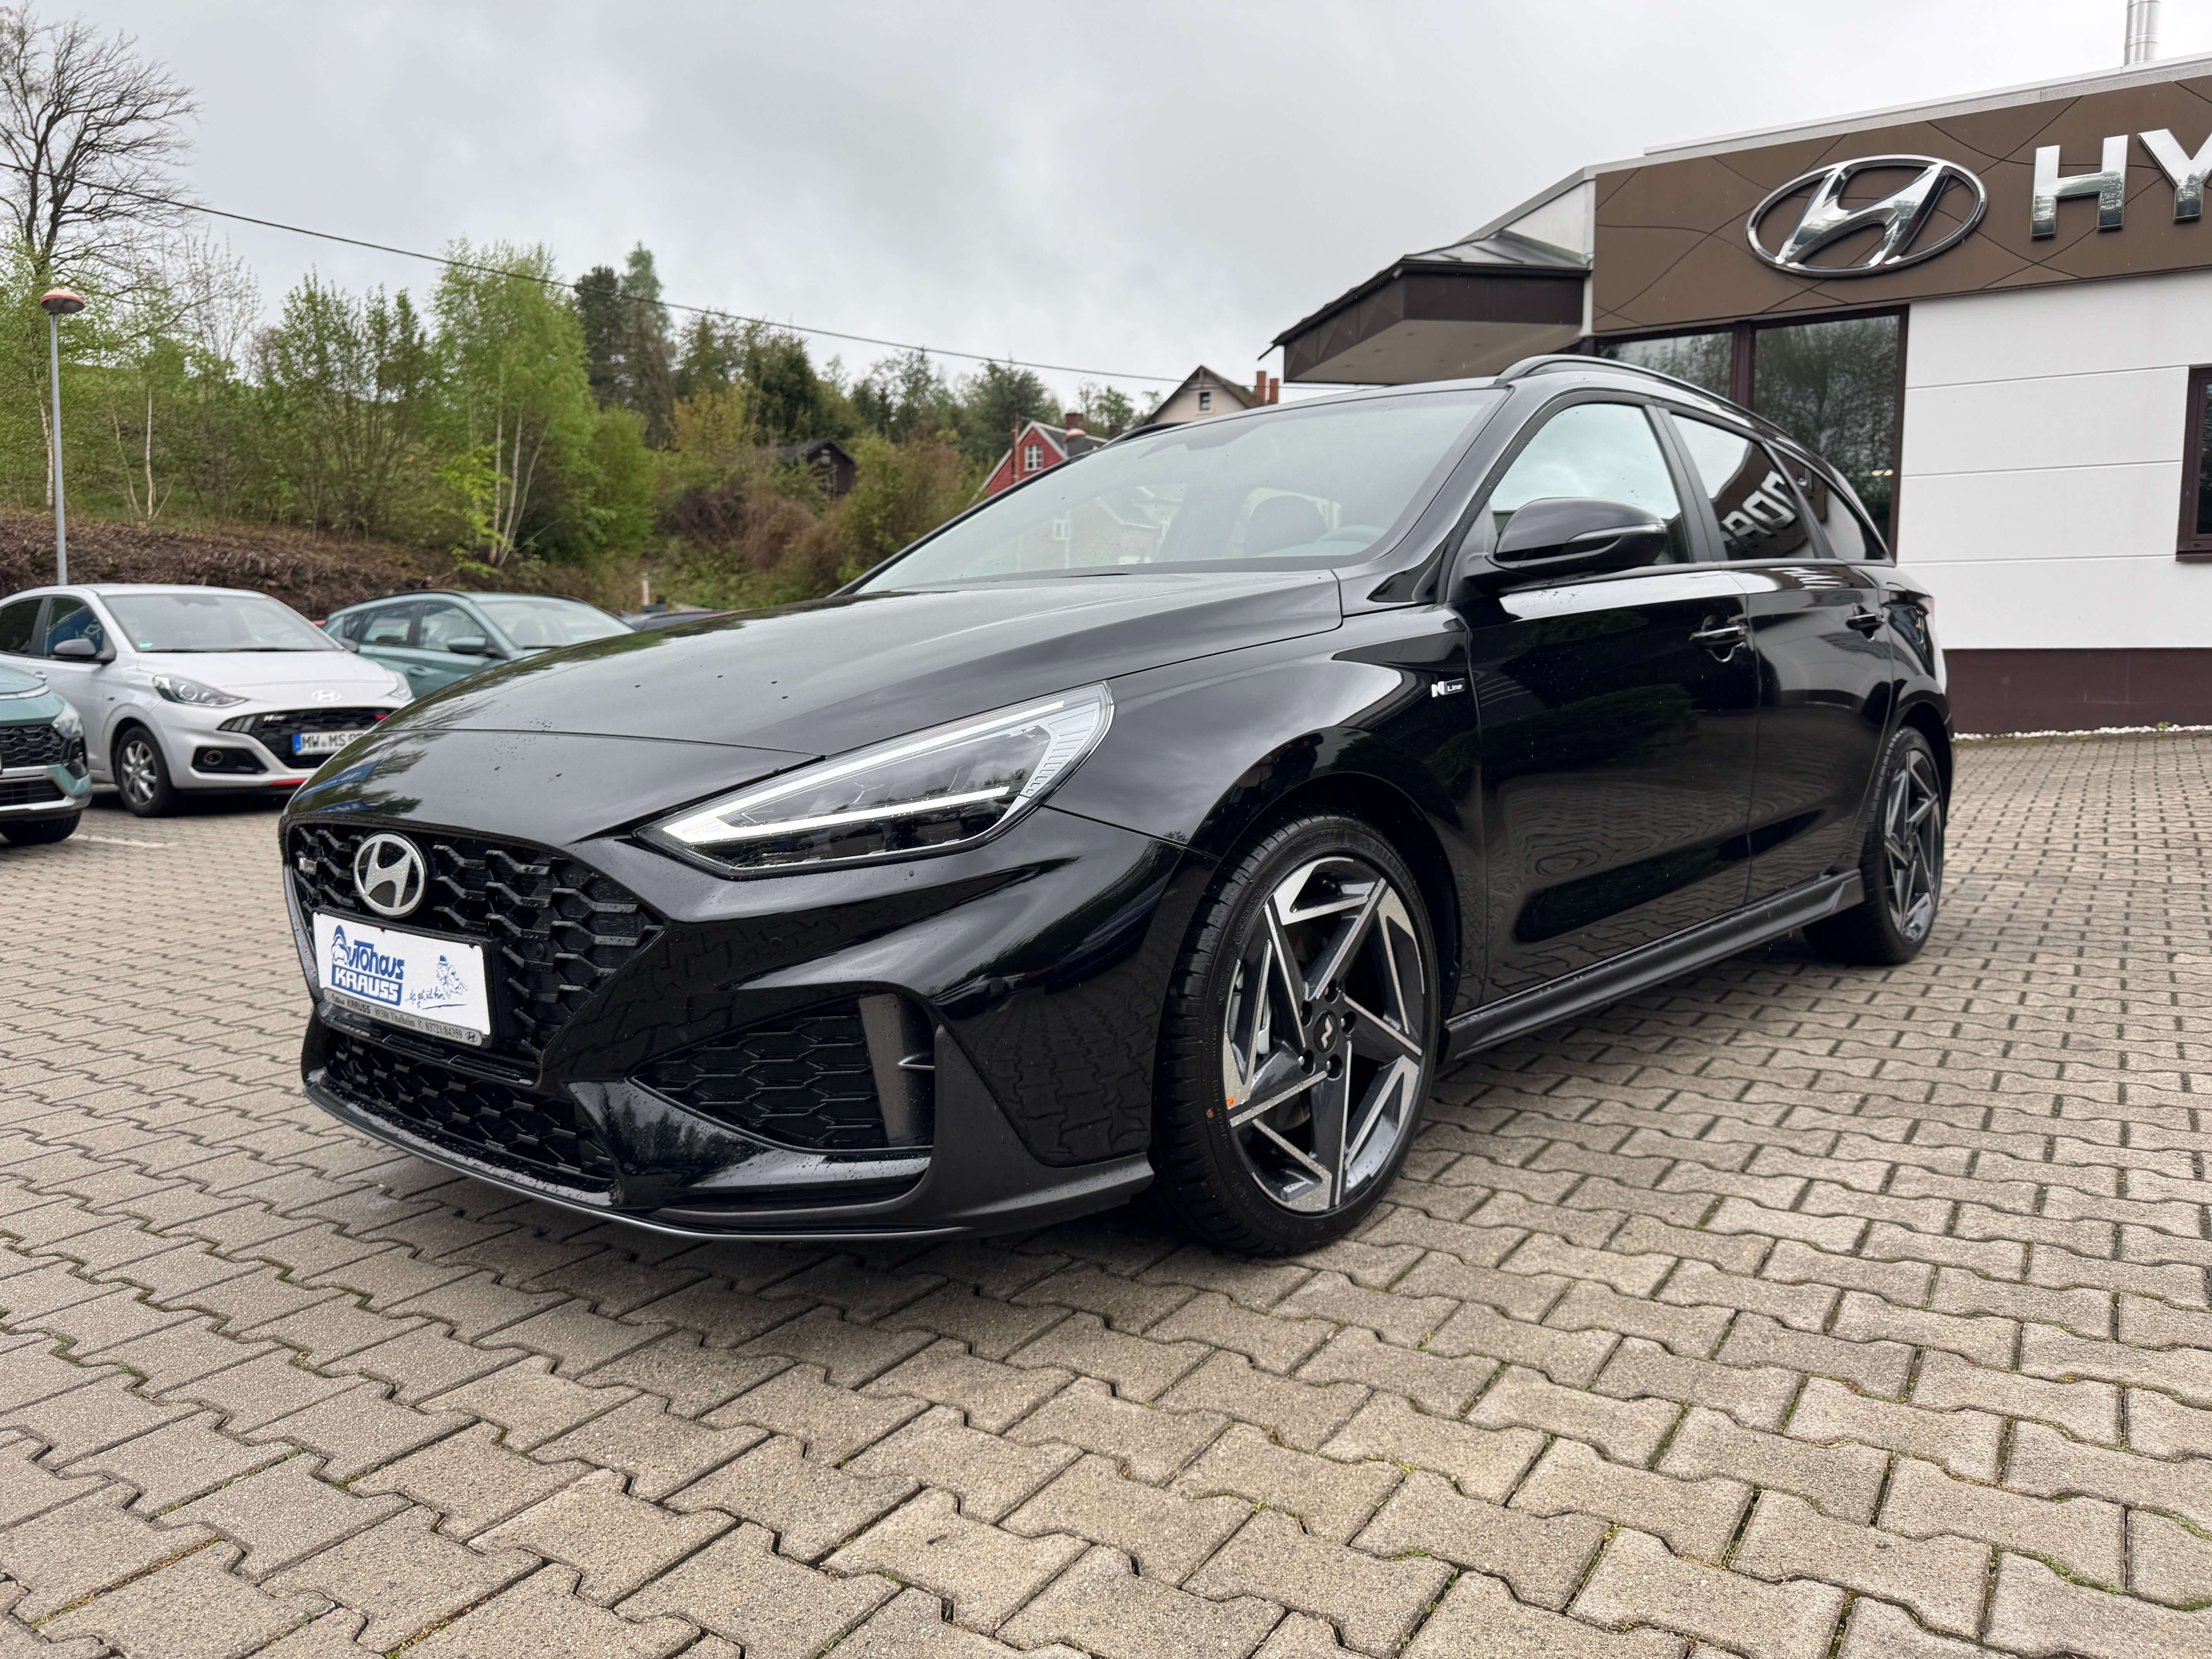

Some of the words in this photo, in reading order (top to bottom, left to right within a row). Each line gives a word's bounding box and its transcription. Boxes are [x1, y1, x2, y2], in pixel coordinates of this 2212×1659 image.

[2030, 128, 2212, 238] HY
[1431, 681, 1445, 697] N
[302, 735, 319, 748] MW
[330, 733, 346, 746] MS
[335, 967, 398, 1002] KRAUSS
[347, 998, 371, 1014] KRAUSS
